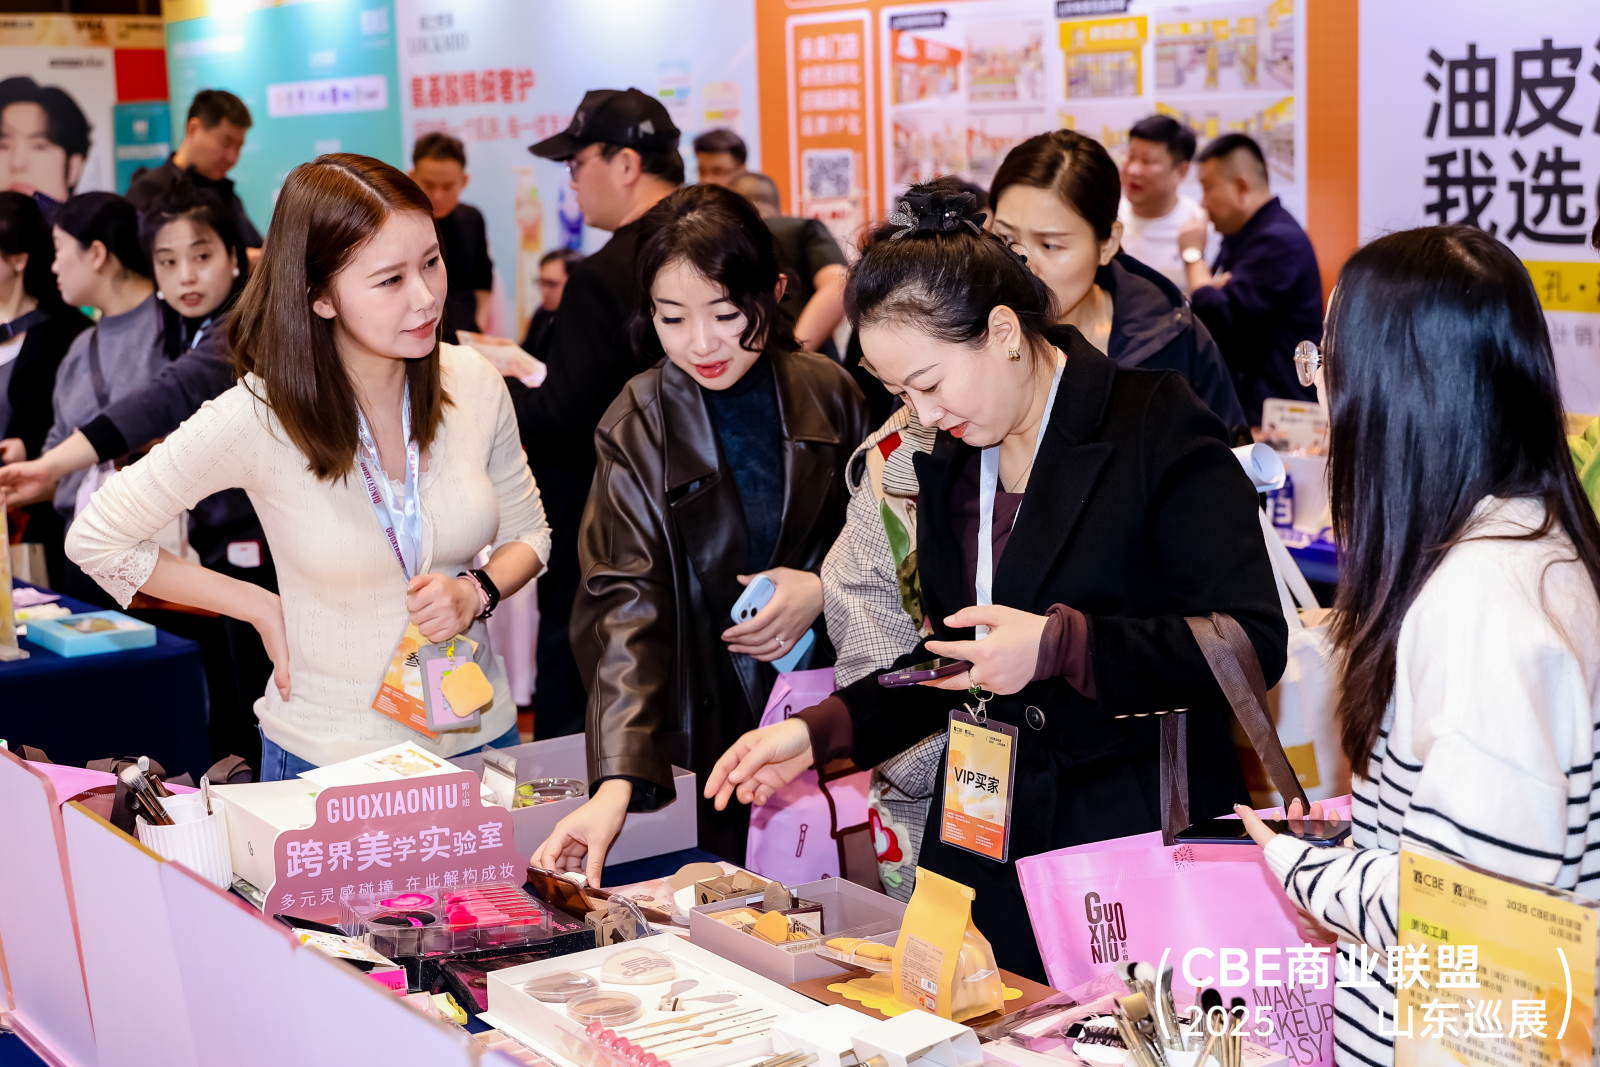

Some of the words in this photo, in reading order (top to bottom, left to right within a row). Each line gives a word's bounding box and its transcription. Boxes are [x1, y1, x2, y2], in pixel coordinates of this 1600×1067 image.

[1423, 38, 1600, 139] 油皮
[1423, 146, 1600, 245] 我选
[954, 766, 1000, 794] VIP买家
[327, 783, 458, 824] GUOXIAONIU
[286, 821, 503, 878] 跨界美学实验室
[280, 878, 394, 911] 多元灵感碰撞
[405, 862, 515, 891] 在此解构成妆
[1423, 874, 1444, 891] CBE
[1411, 919, 1449, 942] 美妆工具
[1506, 899, 1528, 914] 2025
[1530, 907, 1582, 932] CBE商业联盟
[1252, 981, 1317, 1013] MAKE
